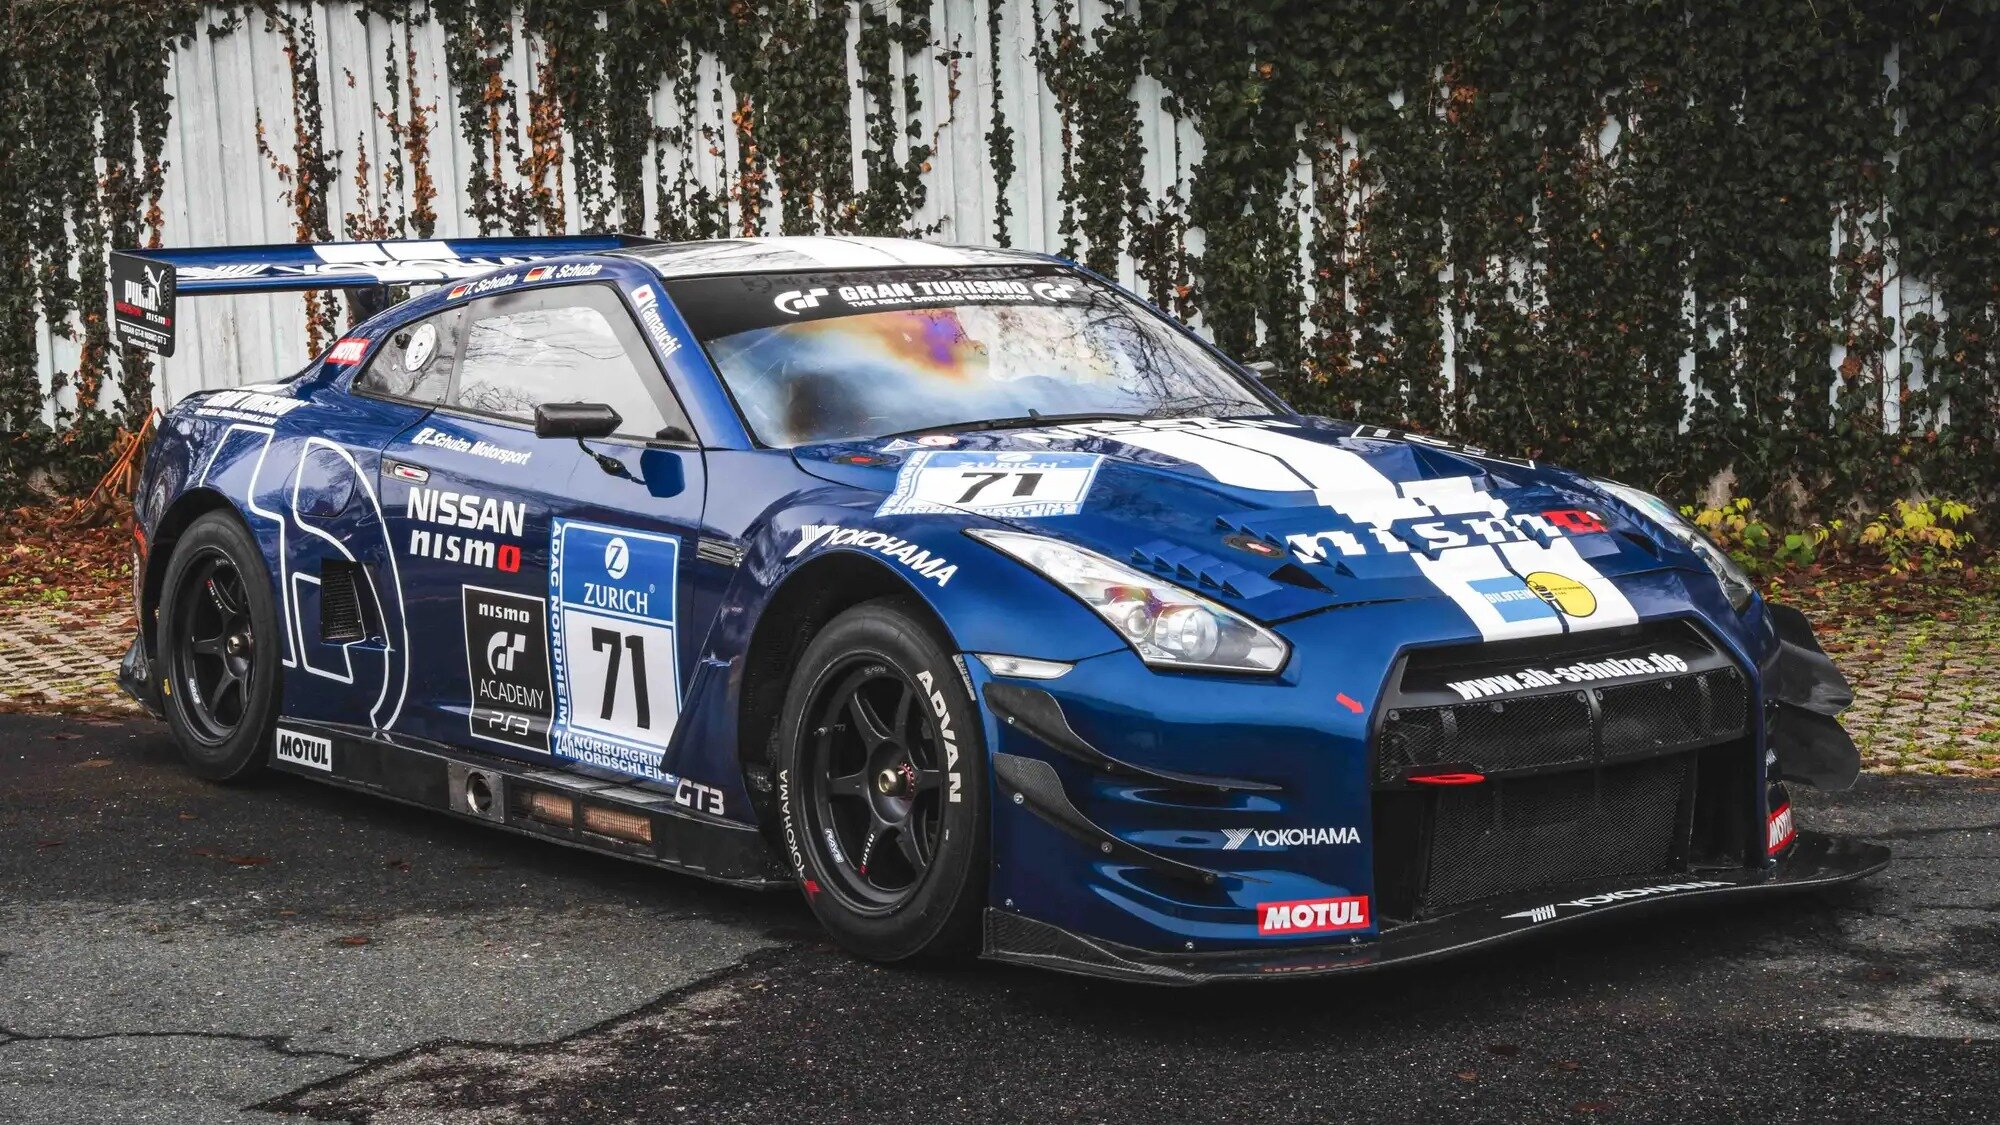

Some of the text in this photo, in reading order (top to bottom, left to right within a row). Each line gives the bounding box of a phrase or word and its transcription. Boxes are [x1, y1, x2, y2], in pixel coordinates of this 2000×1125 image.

[475, 273, 518, 293] Schulze
[555, 262, 603, 278] Schulze
[839, 281, 1029, 301] GRAN TURISMO
[640, 298, 682, 359] Yamauchi
[469, 440, 532, 466] Motorsport
[956, 461, 1056, 469] ZURICH
[955, 472, 1043, 504] 71
[406, 487, 526, 537] NISSAN
[410, 529, 522, 573] nismo
[821, 528, 958, 587] YOKOHAMA
[478, 603, 530, 623] nismo
[583, 582, 649, 615] ZURICH
[550, 520, 568, 726] ADAC NORDHEIM
[591, 627, 650, 730] 71
[1447, 652, 1688, 700] www.ah-schulze.de
[480, 678, 544, 709] ACADEMY
[489, 710, 530, 736] PS3
[916, 669, 962, 802] ADVAN
[279, 734, 328, 765] MOTUL
[554, 730, 663, 767] 24h NÜRBURGRIN
[675, 777, 725, 816] GT3
[779, 769, 806, 881] YOKOHAMA
[1254, 827, 1361, 846] YOKOHAMA
[1557, 880, 1737, 907] YOKOHAMA
[1264, 901, 1364, 930] MOTUL
